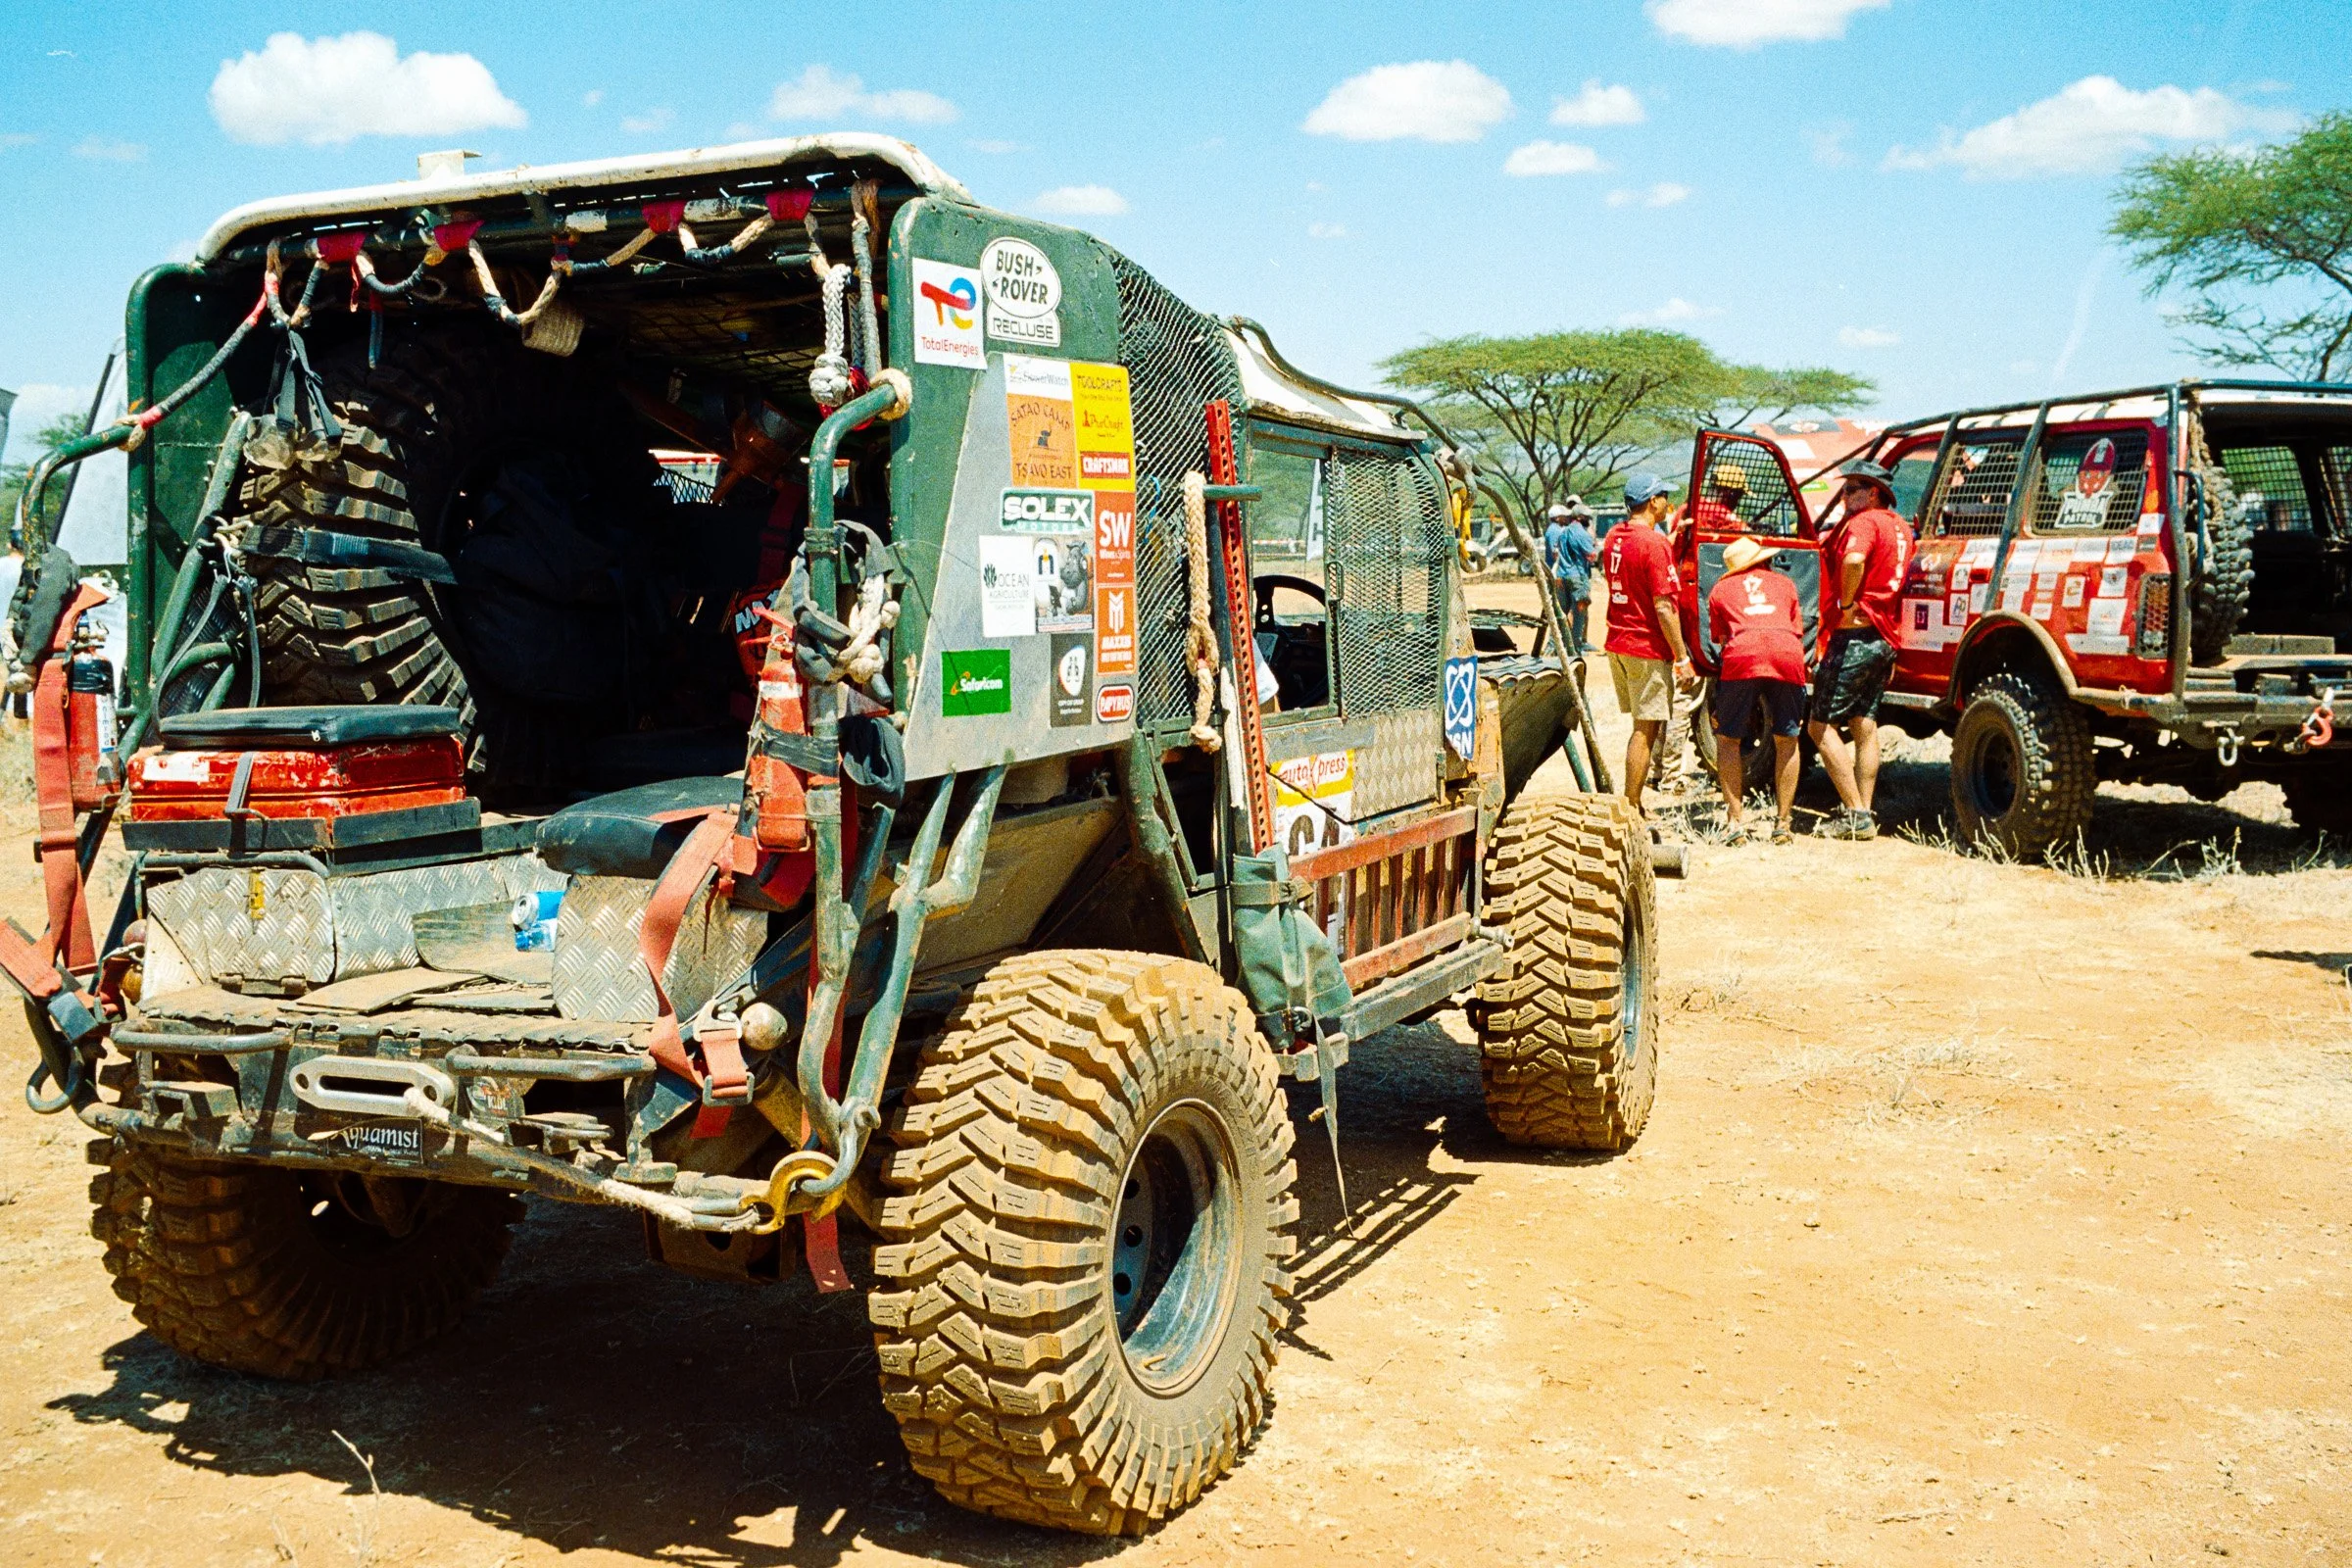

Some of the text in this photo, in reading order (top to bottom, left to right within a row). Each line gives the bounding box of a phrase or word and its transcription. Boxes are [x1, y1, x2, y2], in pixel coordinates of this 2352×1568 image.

[996, 250, 1034, 274] BUSH
[1000, 279, 1048, 305] ROVER
[993, 317, 1054, 340] RECLUSE
[921, 336, 978, 357] TotalEnergies
[1010, 402, 1041, 427] SATAO
[1043, 404, 1071, 431] CAMP
[1016, 463, 1071, 479] TSAVO EAST
[1004, 496, 1091, 528] SOLEX
[1099, 510, 1132, 548] SW
[998, 573, 1030, 587] OCEAN
[960, 676, 1003, 692] Safaricom
[1100, 694, 1132, 712] PAPYRUS
